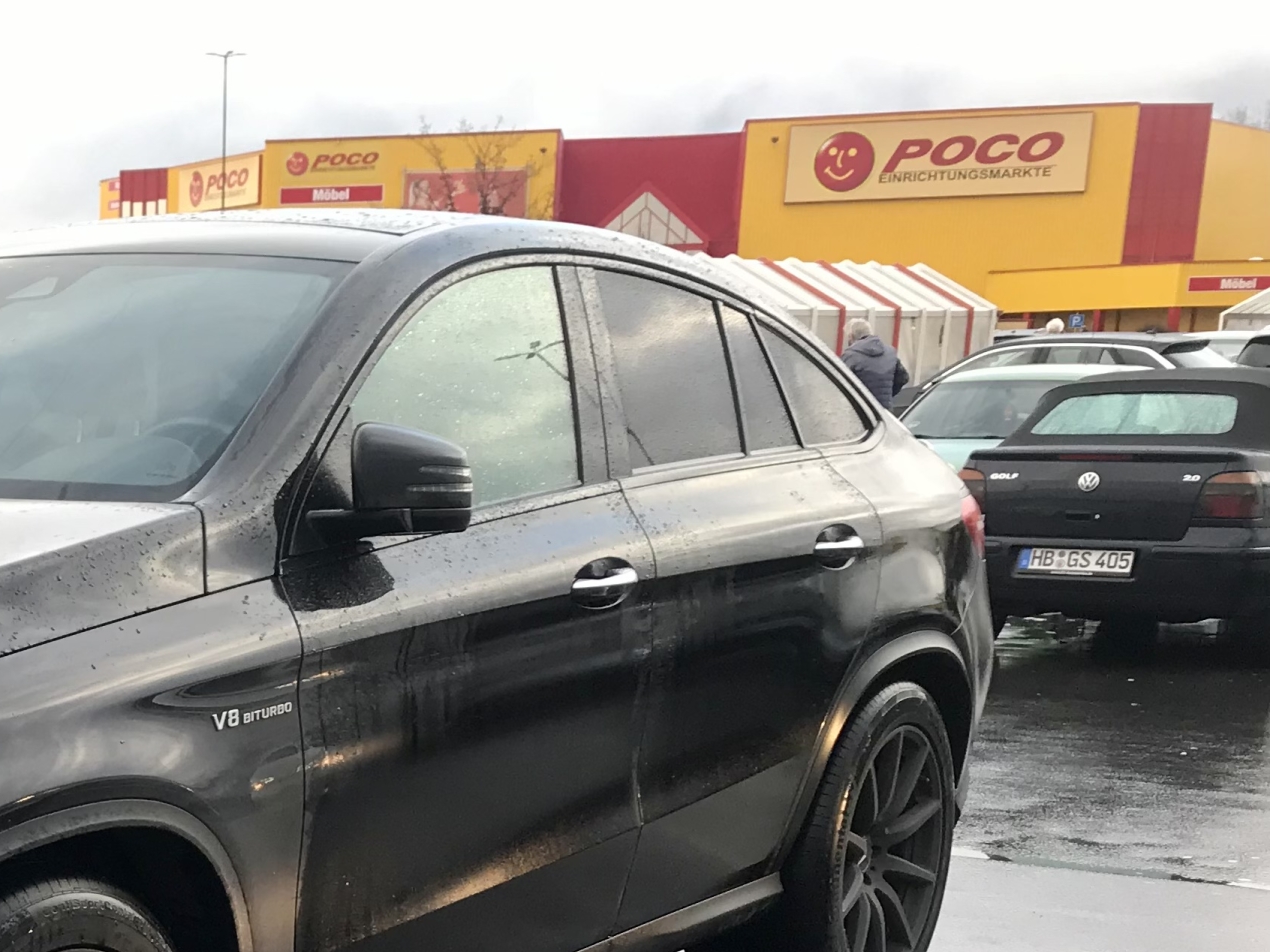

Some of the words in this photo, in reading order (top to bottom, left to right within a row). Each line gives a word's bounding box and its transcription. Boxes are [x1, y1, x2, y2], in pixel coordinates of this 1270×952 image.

[311, 152, 380, 169] POCO
[882, 131, 1065, 173] POCO
[205, 168, 249, 196] POCO
[312, 187, 350, 201] Möbel
[1220, 277, 1258, 290] Möbel
[1030, 549, 1055, 567] HB
[1067, 550, 1092, 568] GS
[1095, 551, 1132, 569] 405
[212, 708, 240, 731] V8
[243, 701, 293, 724] BITURBO
